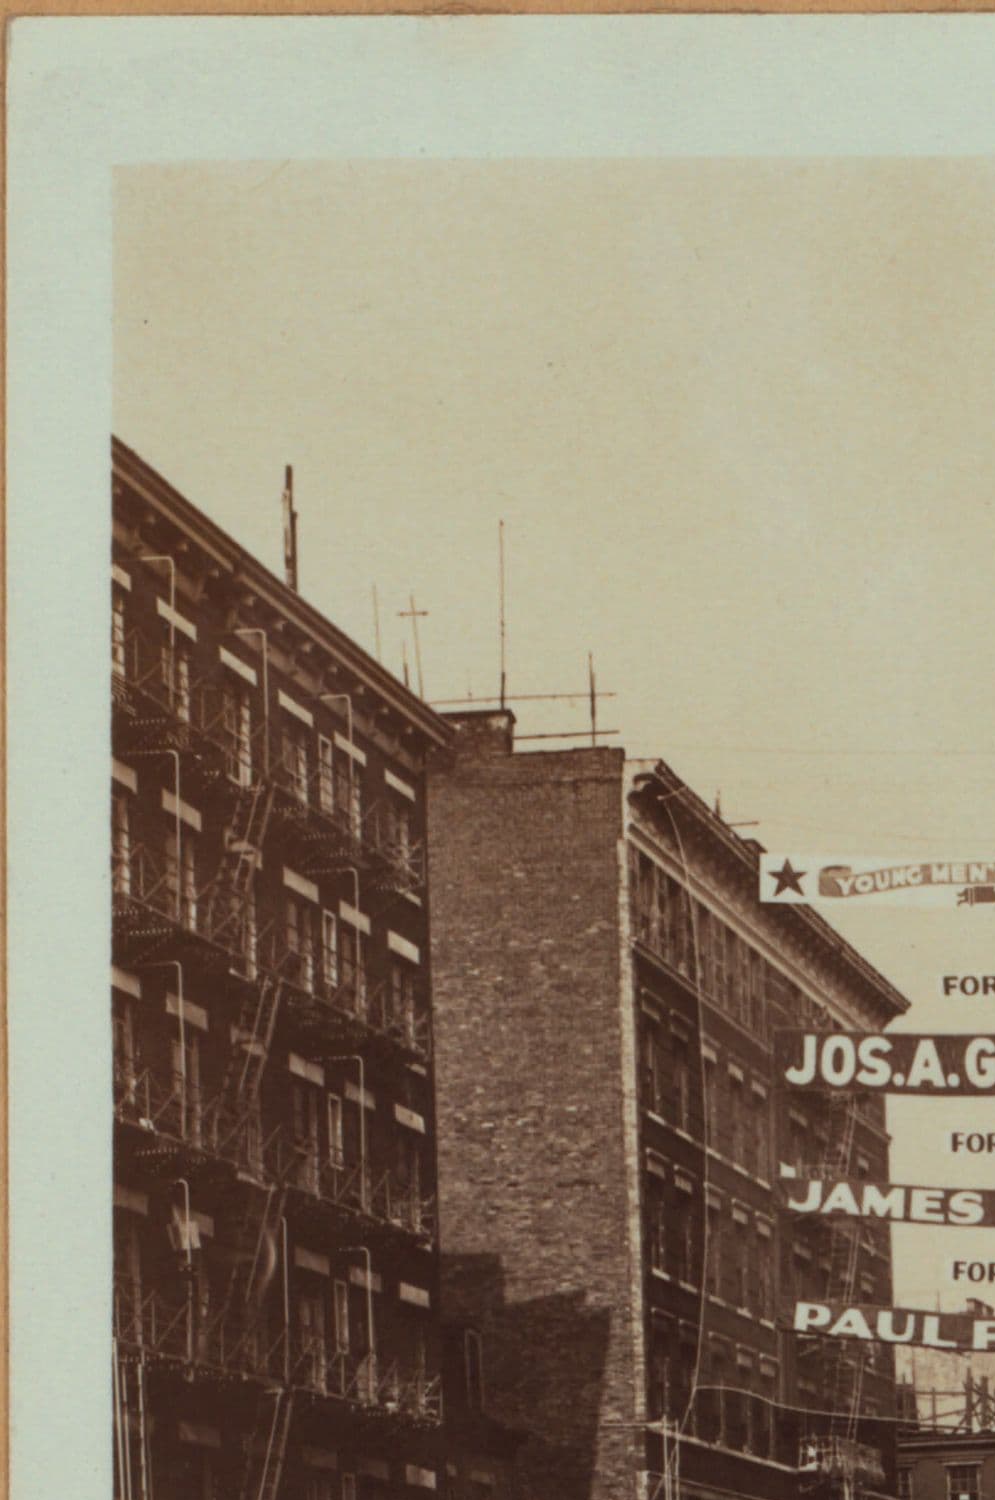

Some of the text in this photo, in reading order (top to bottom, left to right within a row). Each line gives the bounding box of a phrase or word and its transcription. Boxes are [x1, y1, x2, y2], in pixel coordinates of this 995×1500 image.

[835, 866, 923, 896] YOUNG
[787, 1179, 985, 1226] JAMES
[793, 1301, 958, 1349] PAUL
